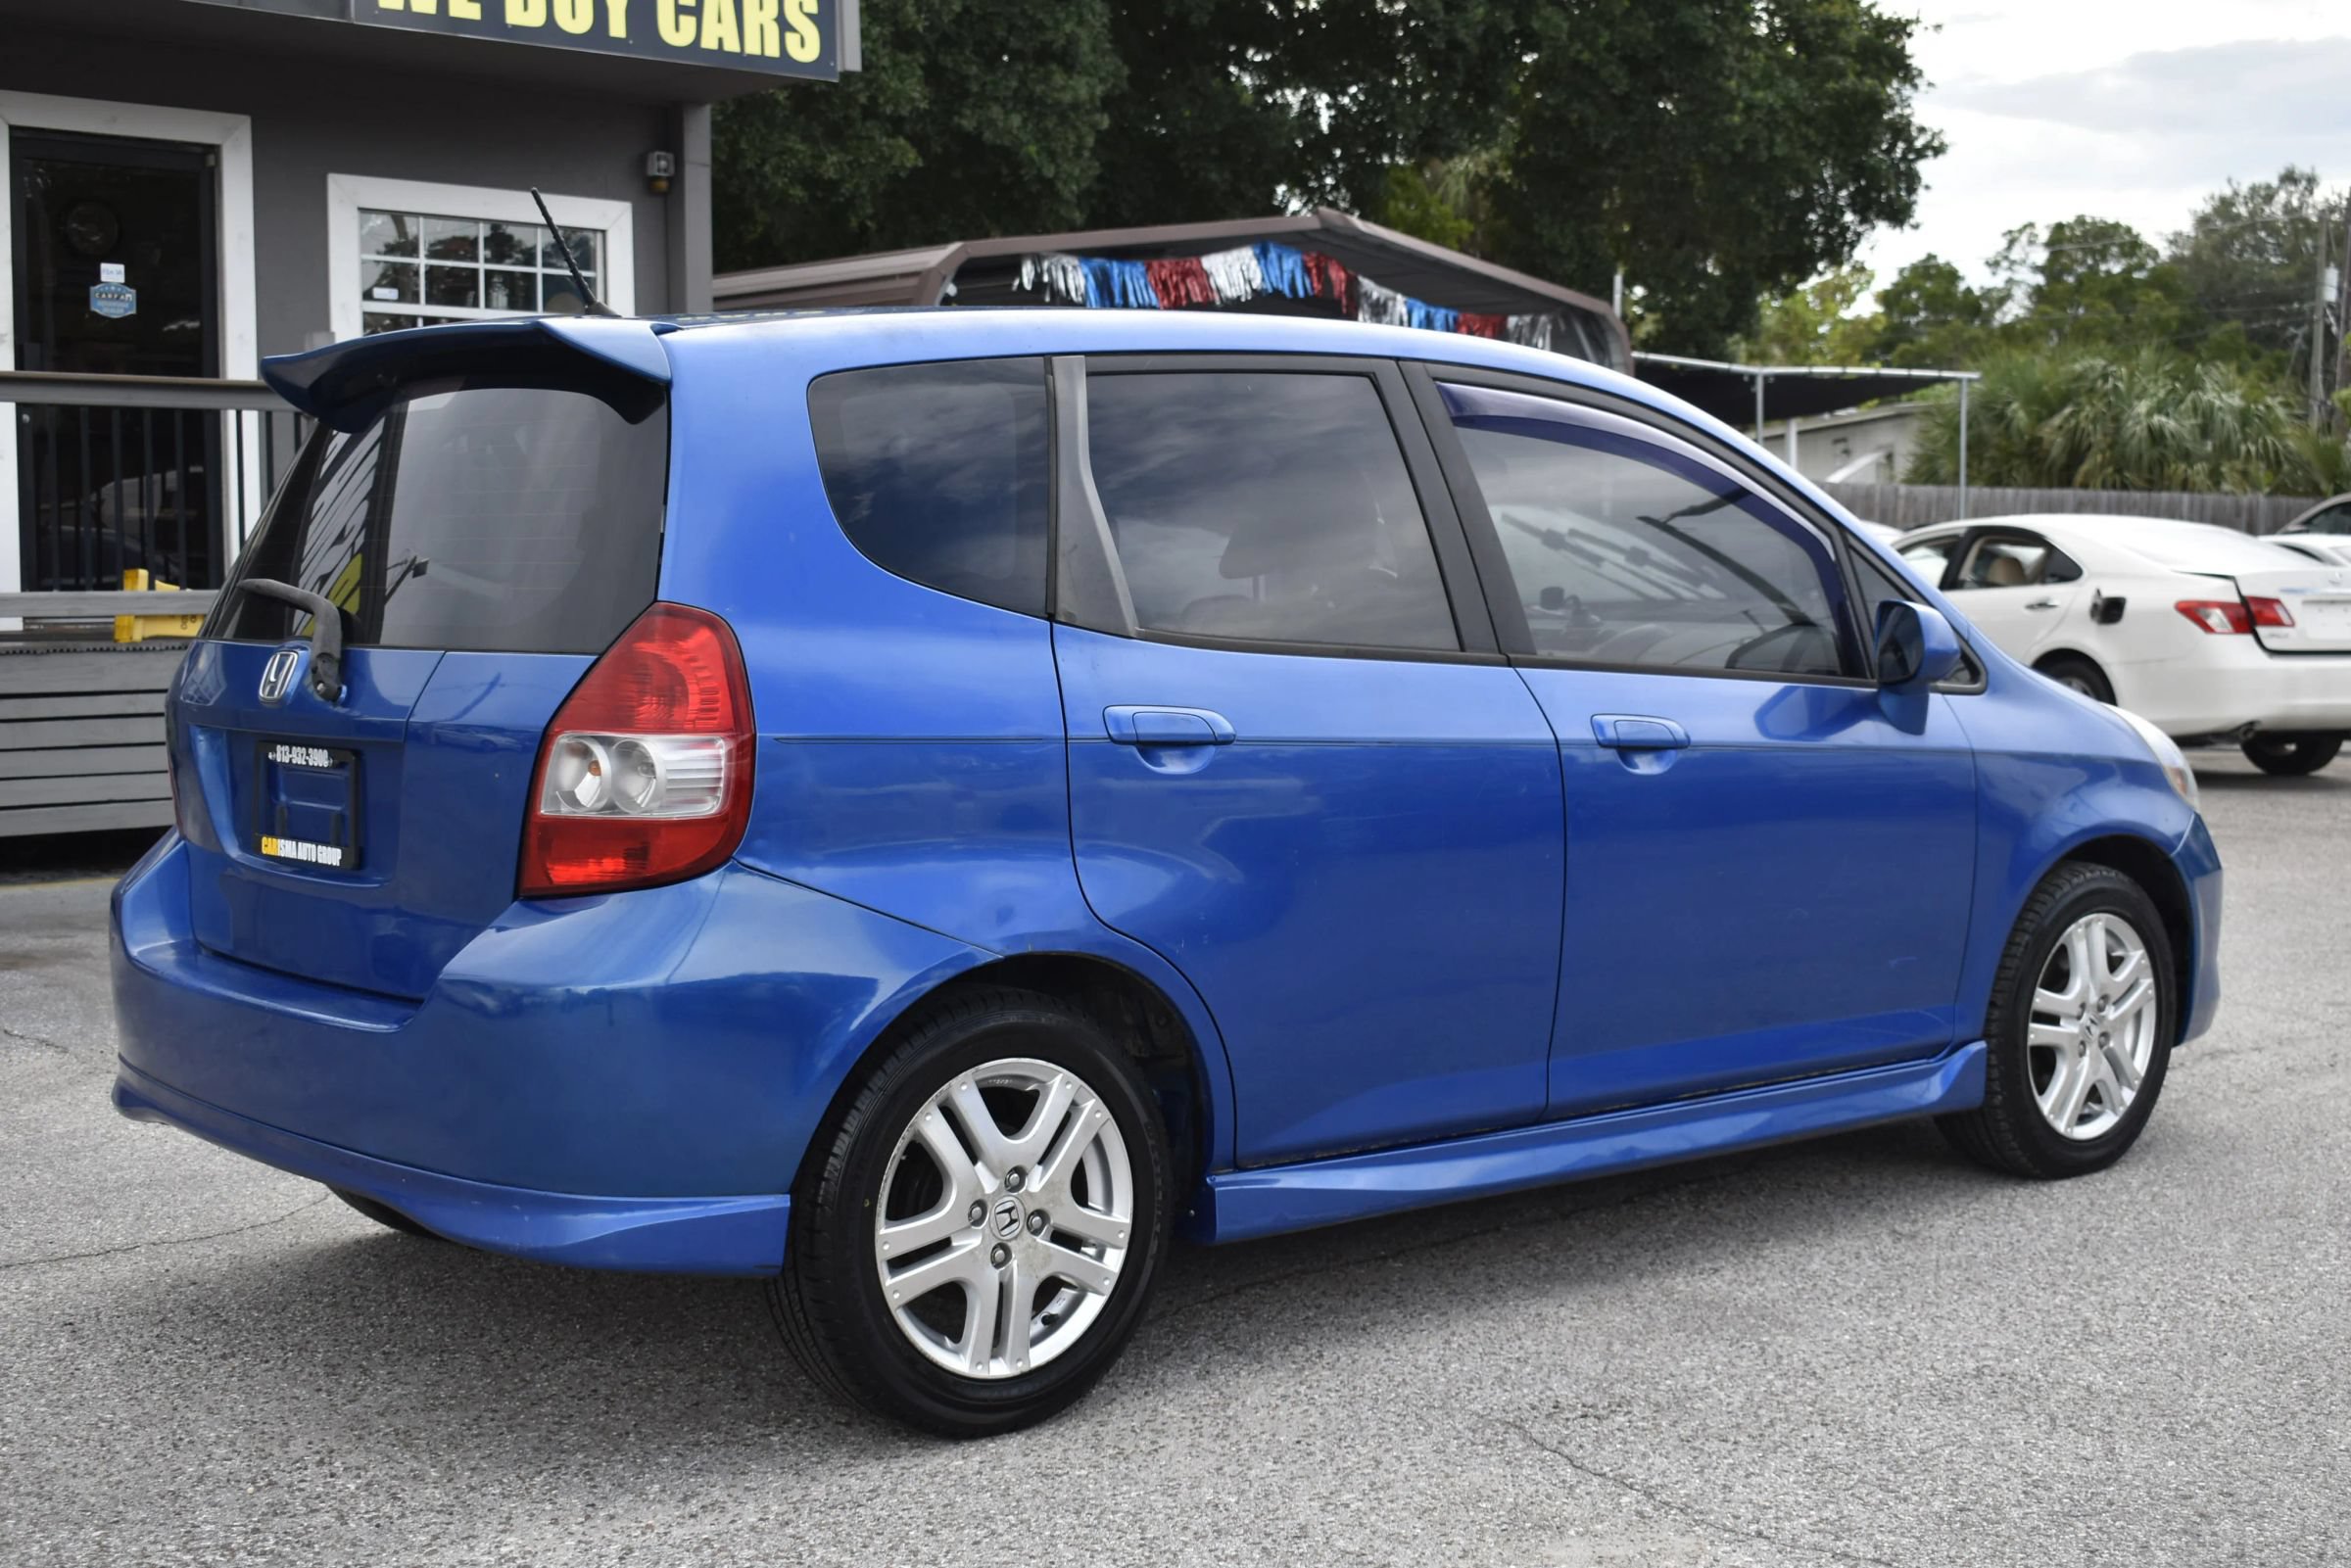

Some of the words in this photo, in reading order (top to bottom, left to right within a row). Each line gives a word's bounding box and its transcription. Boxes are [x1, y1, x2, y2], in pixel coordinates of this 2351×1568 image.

[656, 0, 821, 63] CARS
[298, 841, 316, 862] AUTO
[317, 845, 342, 867] GROUP
